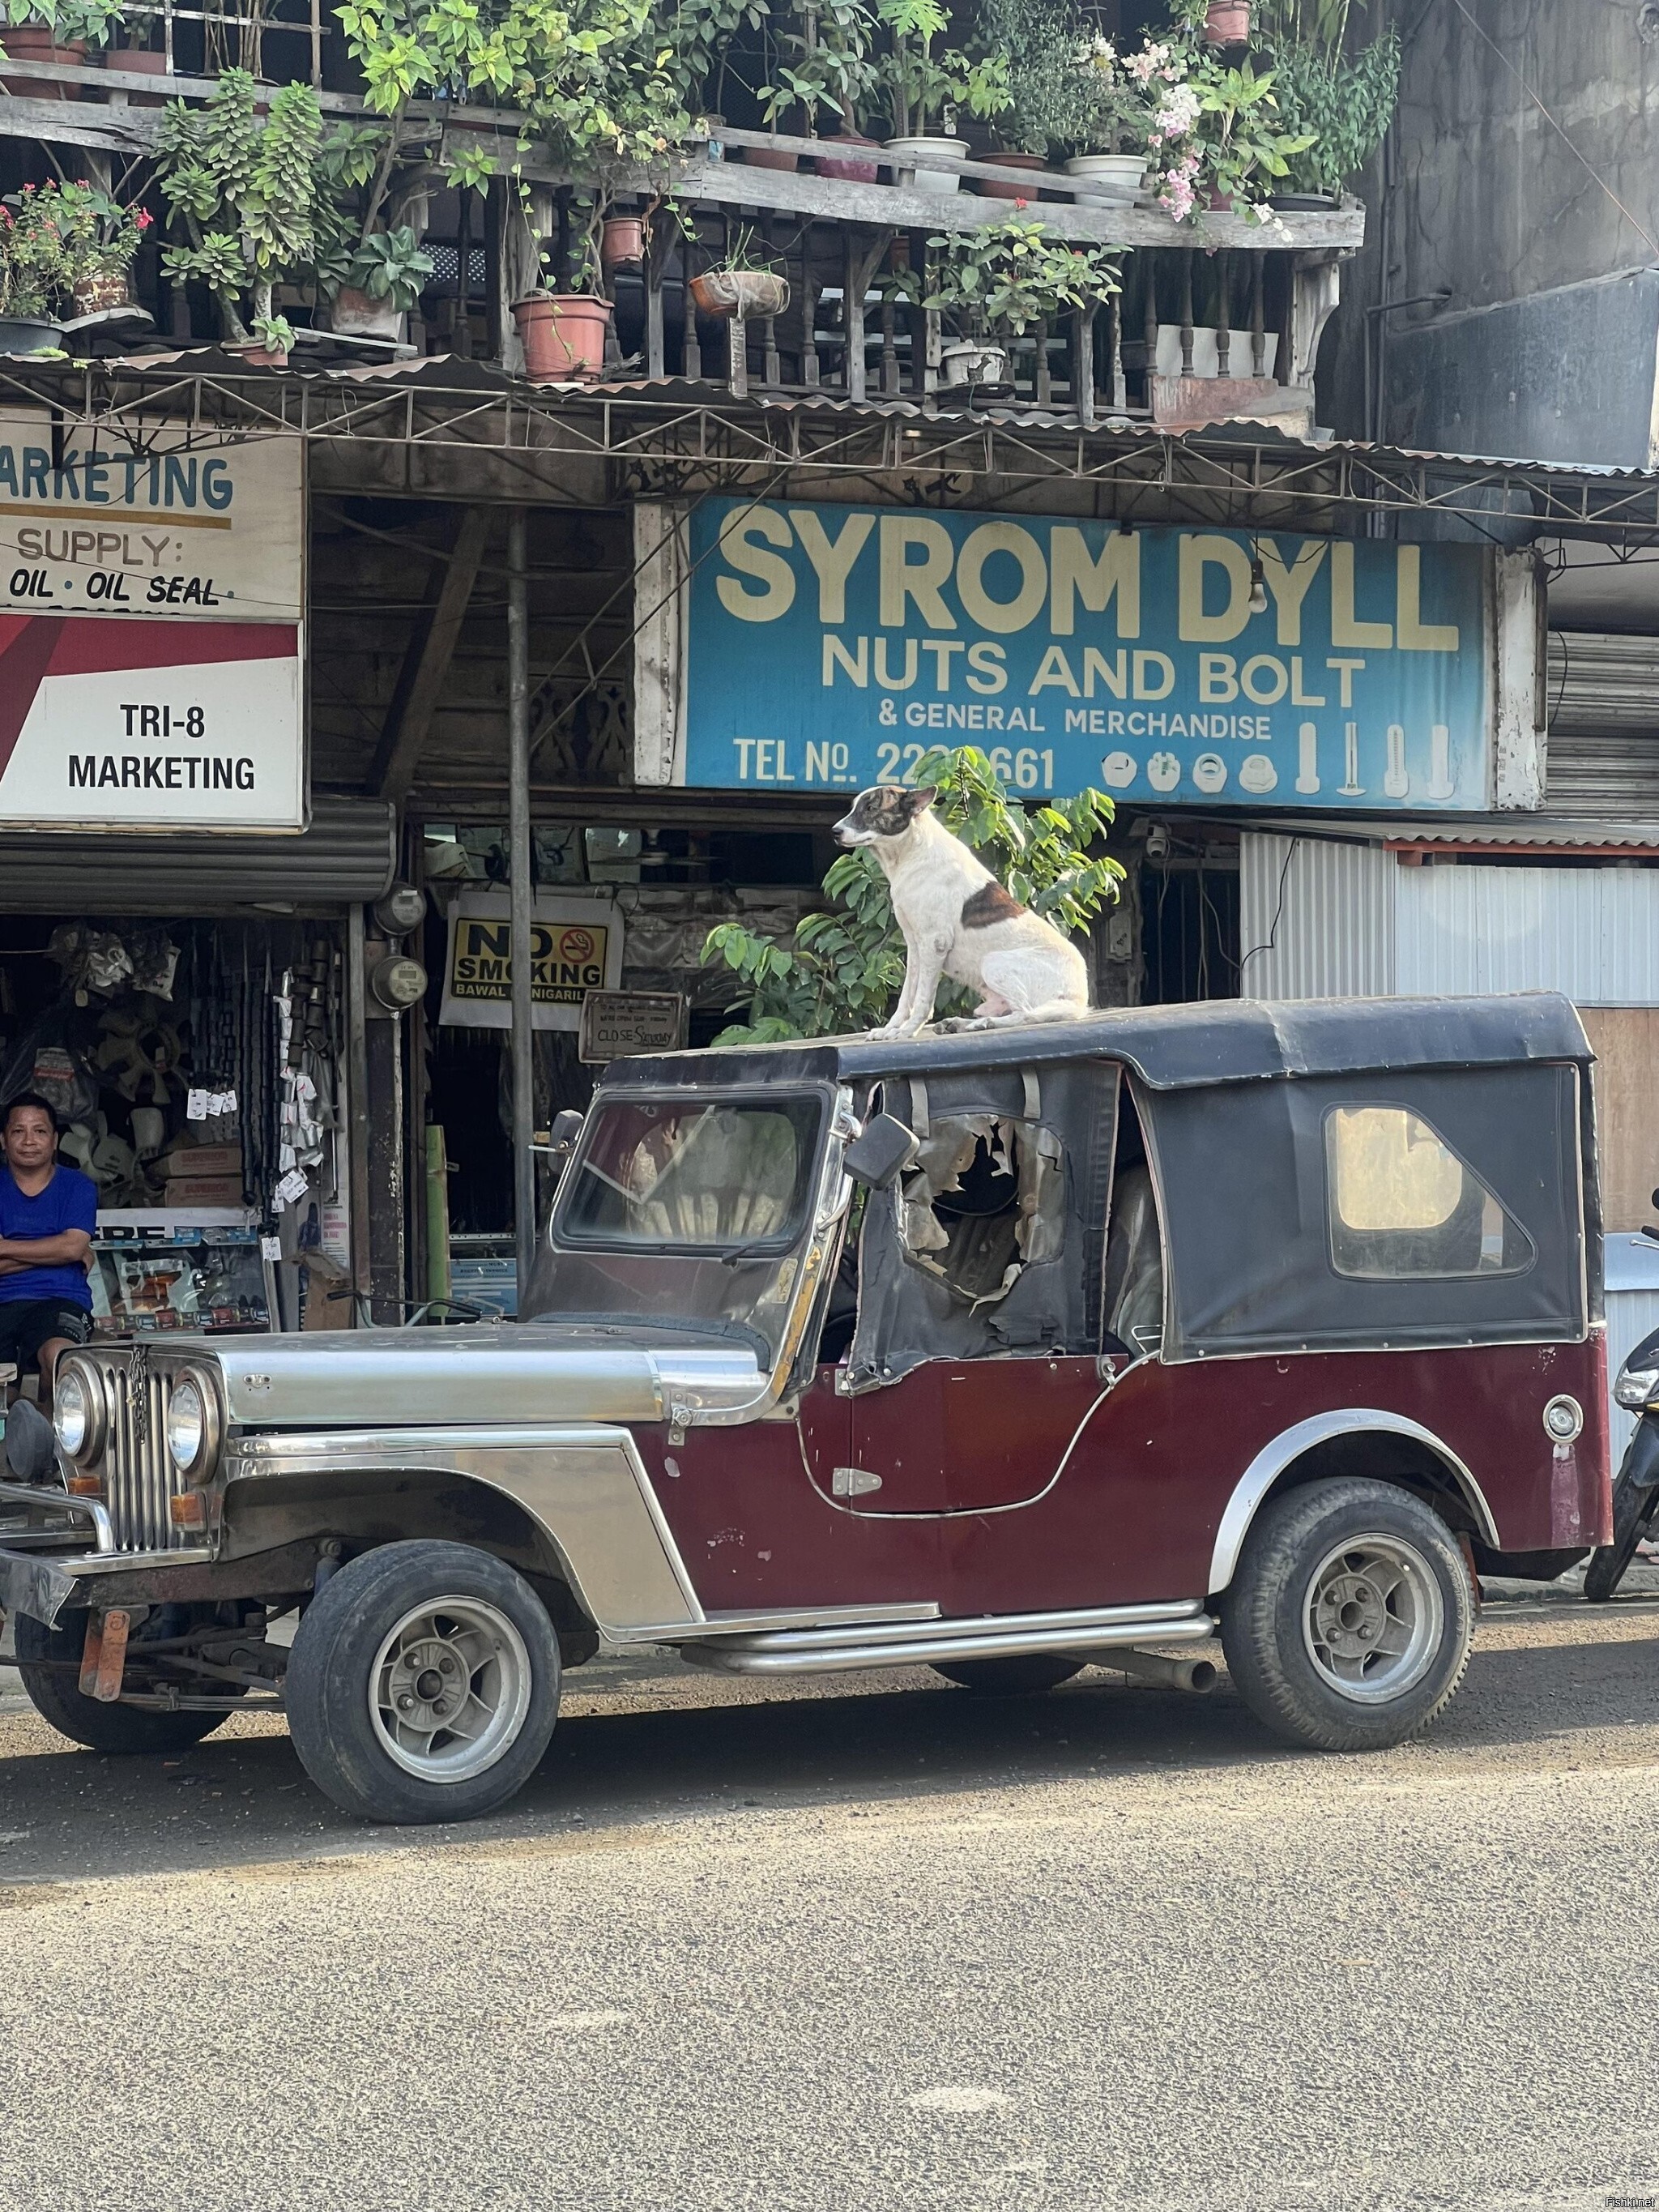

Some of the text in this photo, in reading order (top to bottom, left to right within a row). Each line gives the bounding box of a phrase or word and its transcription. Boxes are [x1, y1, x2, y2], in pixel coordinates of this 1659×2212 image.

[17, 528, 183, 566] SUPPLY:
[10, 569, 219, 606] OIL OIL SEAL
[715, 503, 1459, 651] SYROM DYLL
[822, 634, 1366, 707] NUTS AND BOLT
[120, 703, 205, 738] TRI-8
[879, 698, 1272, 741] & GENERAL MERCHANDISE
[69, 755, 254, 790] MARKETING
[733, 738, 795, 781] TEL
[456, 983, 506, 997] BAWAL
[458, 958, 600, 986] SMKING
[598, 1029, 633, 1042] CLOSE
